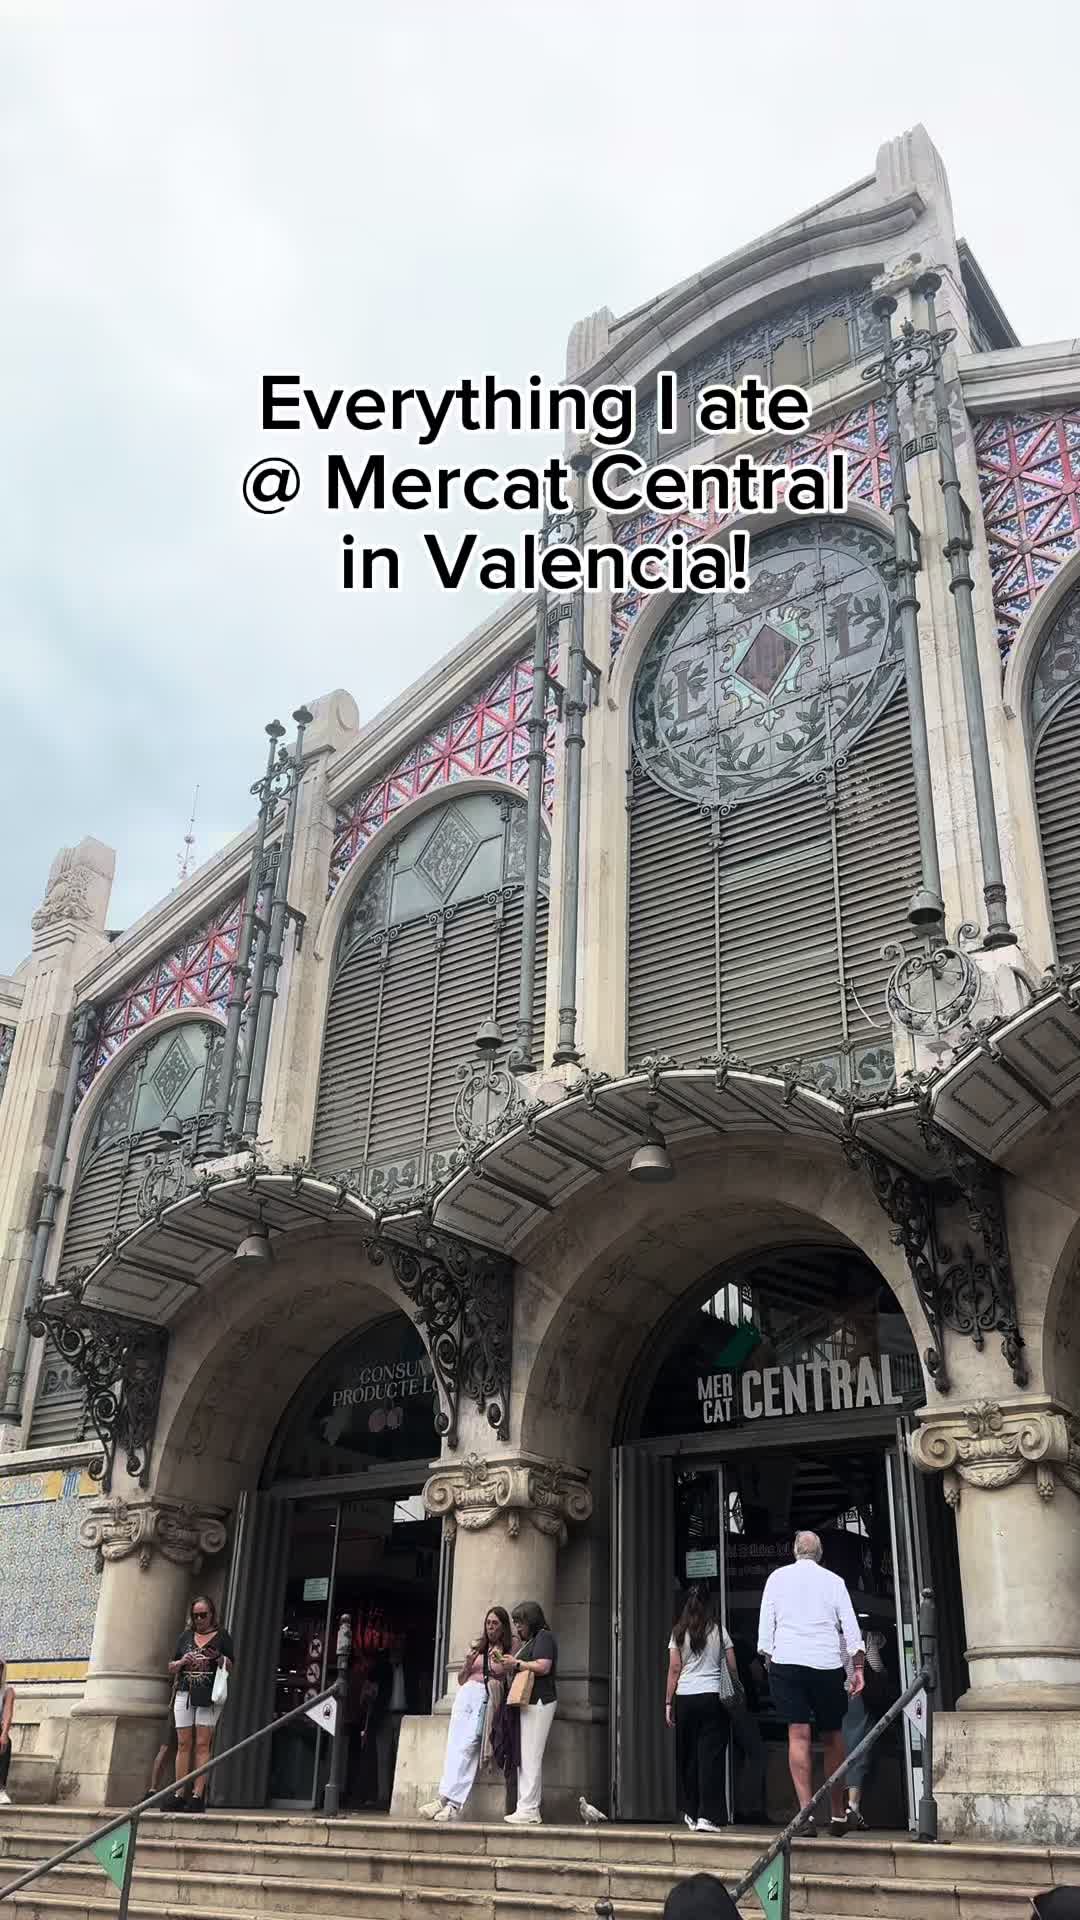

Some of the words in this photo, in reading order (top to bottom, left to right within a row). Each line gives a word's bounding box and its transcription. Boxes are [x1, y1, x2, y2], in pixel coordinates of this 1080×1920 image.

[332, 1378, 419, 1407] PRODUCTE
[697, 1373, 733, 1400] MER
[741, 1354, 903, 1419] CENTRAL
[703, 1397, 733, 1424] CAT
